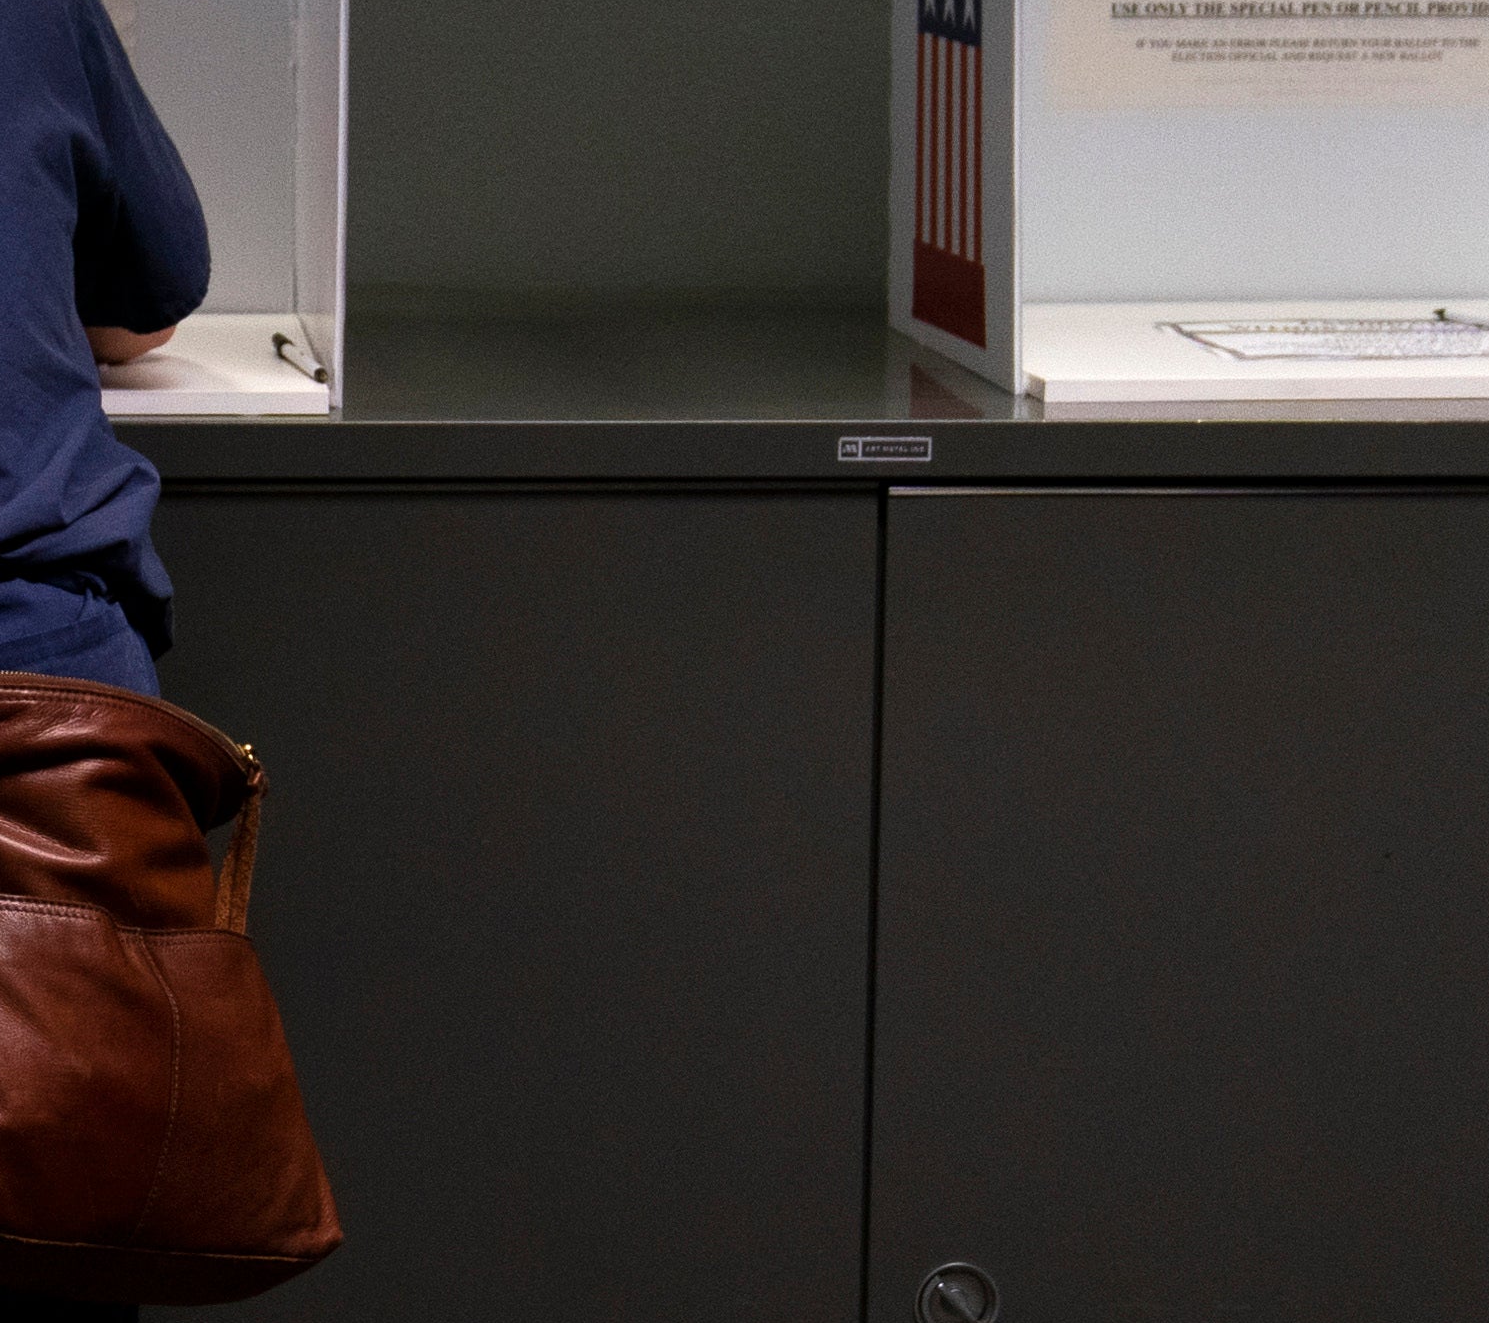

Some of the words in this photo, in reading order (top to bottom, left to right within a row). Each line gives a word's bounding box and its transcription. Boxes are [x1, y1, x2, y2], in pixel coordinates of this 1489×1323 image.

[1111, 2, 1139, 18] USE
[1143, 2, 1189, 18] ONLY
[1194, 2, 1225, 18] THE
[1229, 2, 1296, 18] SPECIAL
[1300, 2, 1331, 18] PEN
[1335, 2, 1359, 18] OR
[1364, 2, 1421, 18] PENCIL
